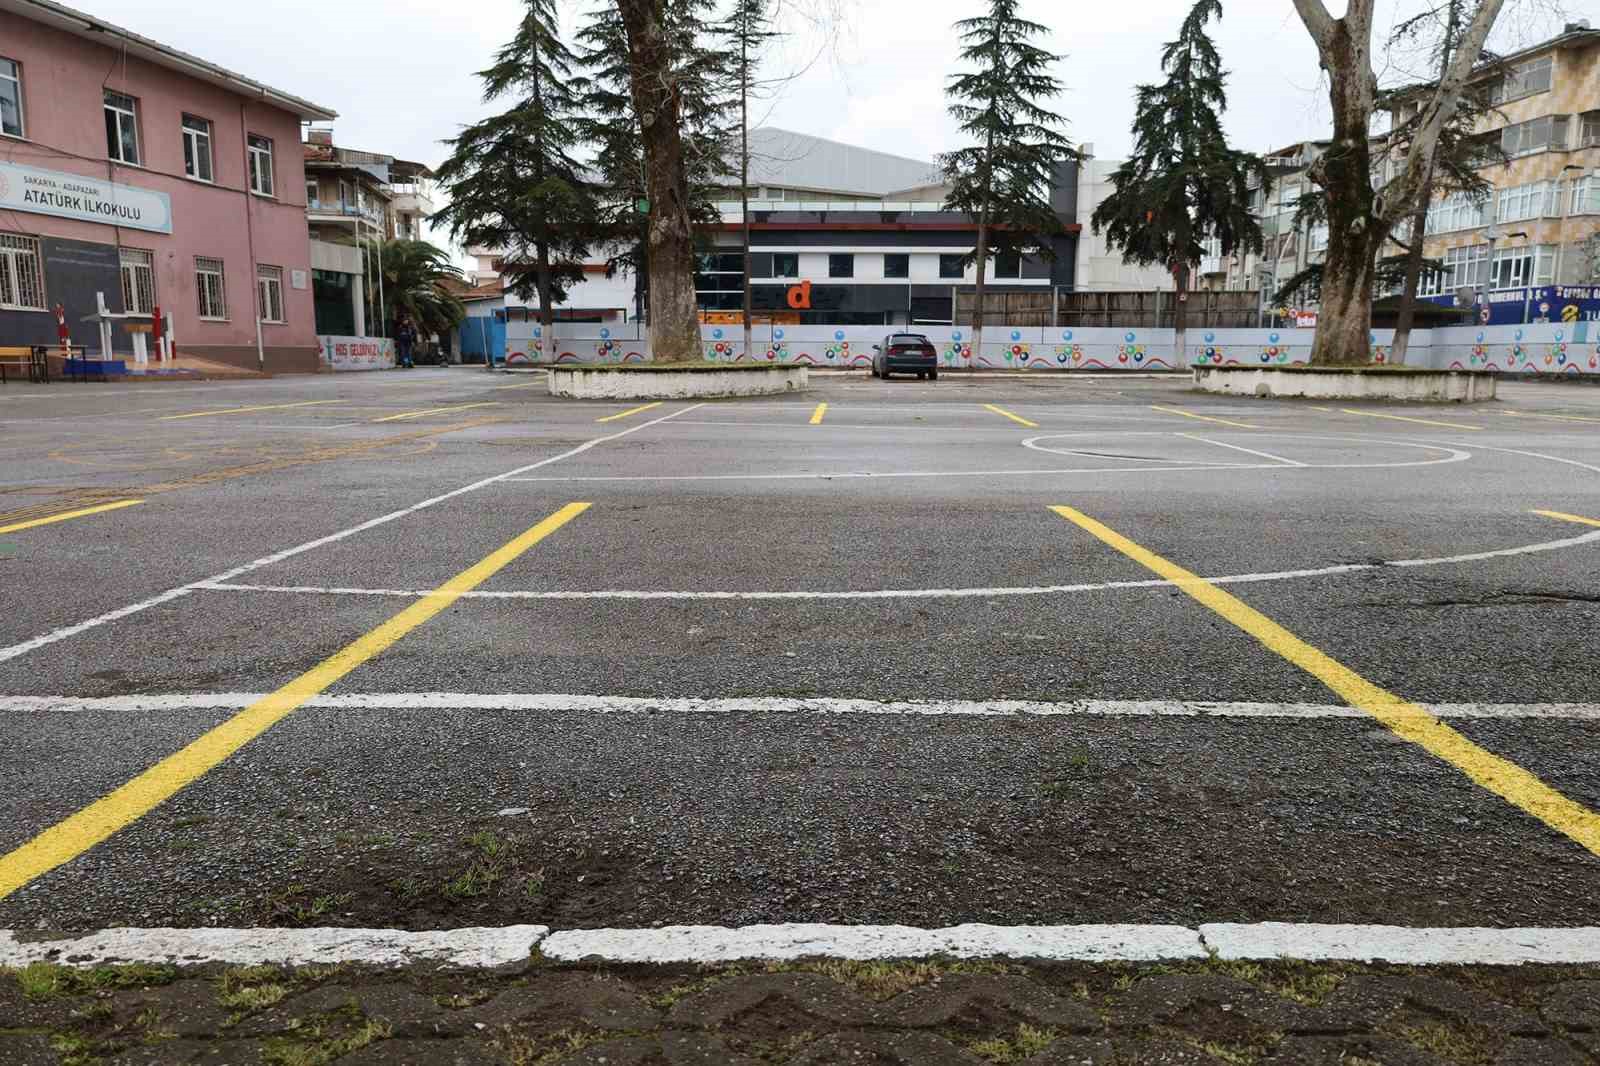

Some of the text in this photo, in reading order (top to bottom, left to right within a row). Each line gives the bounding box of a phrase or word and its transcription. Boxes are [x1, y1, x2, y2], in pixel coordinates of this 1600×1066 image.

[24, 175, 57, 188] SAKARYA
[24, 189, 142, 220] ATATÜRK İLKOKULU
[787, 280, 811, 309] d
